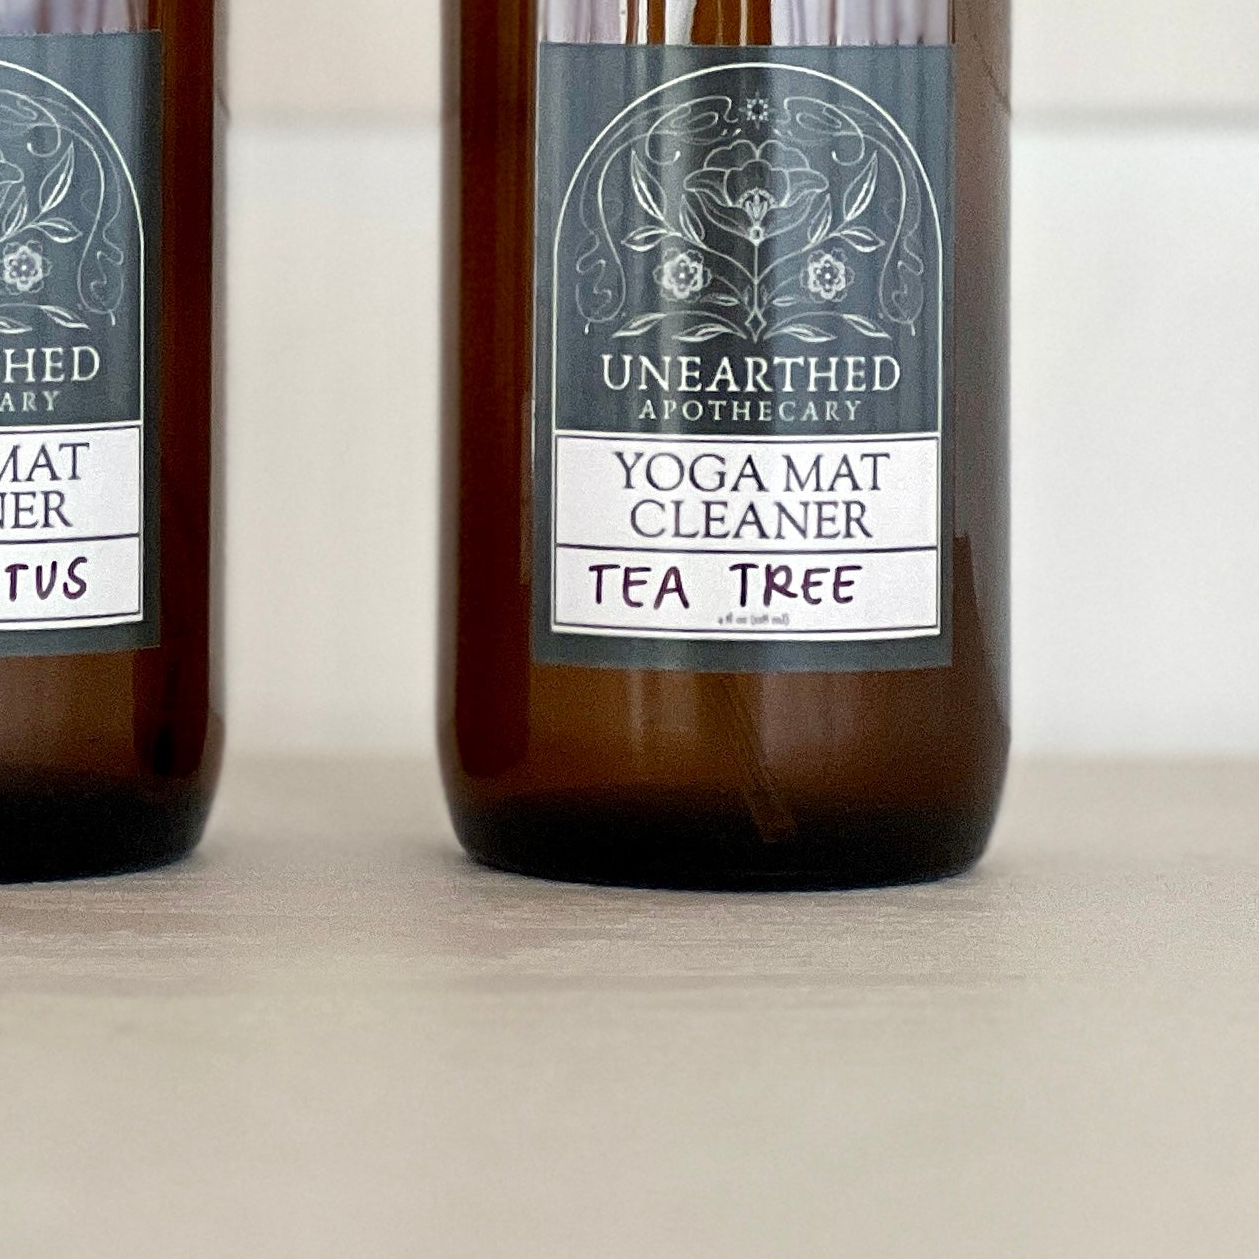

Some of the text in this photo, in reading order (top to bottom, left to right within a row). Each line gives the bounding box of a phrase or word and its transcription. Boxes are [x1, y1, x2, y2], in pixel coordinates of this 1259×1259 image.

[600, 353, 902, 393] UNEARTHED
[638, 399, 863, 422] APOTHECARY
[614, 451, 891, 494] YOGA MAT
[629, 499, 874, 540] CLEANER
[588, 562, 863, 610] TEA TREE
